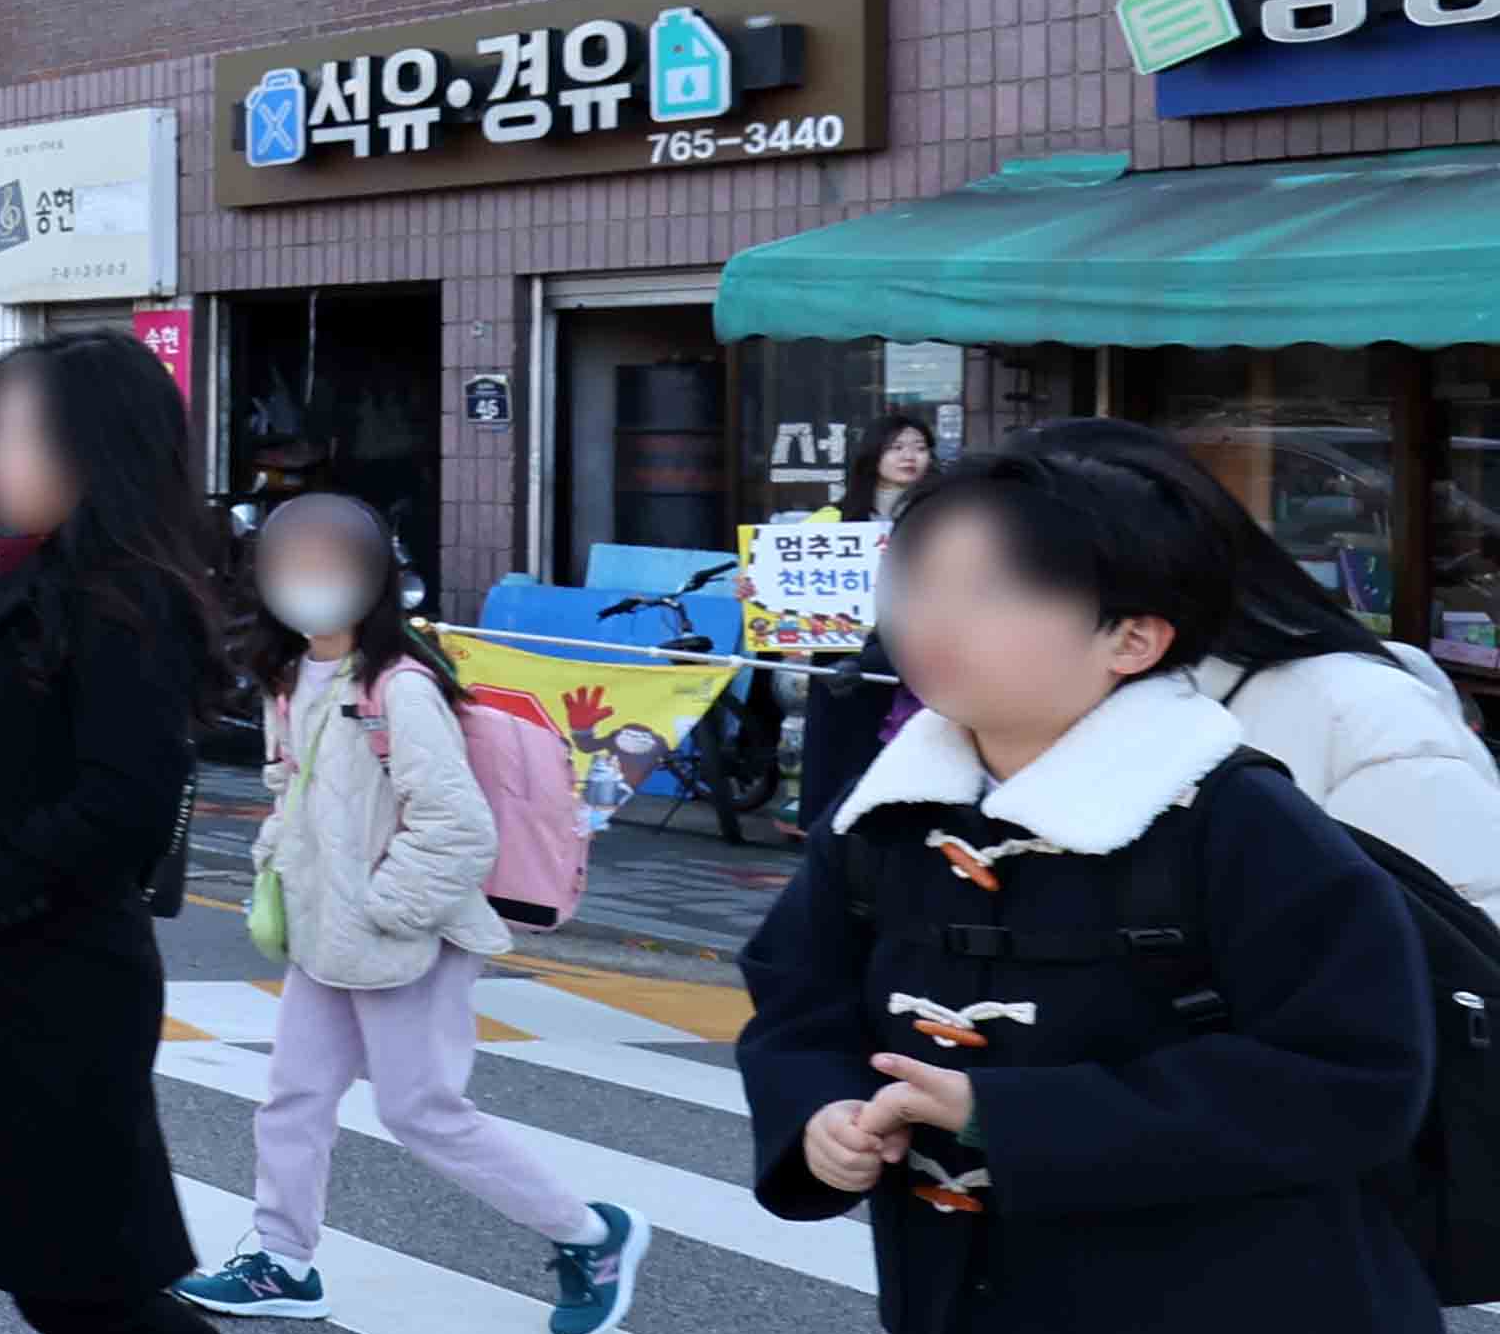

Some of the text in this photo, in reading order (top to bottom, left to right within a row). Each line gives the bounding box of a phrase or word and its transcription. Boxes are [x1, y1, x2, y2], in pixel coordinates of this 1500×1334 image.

[648, 114, 845, 165] 765-3440
[35, 187, 74, 235] 송현
[775, 534, 864, 562] 멈추고
[778, 569, 871, 596] 천천히
